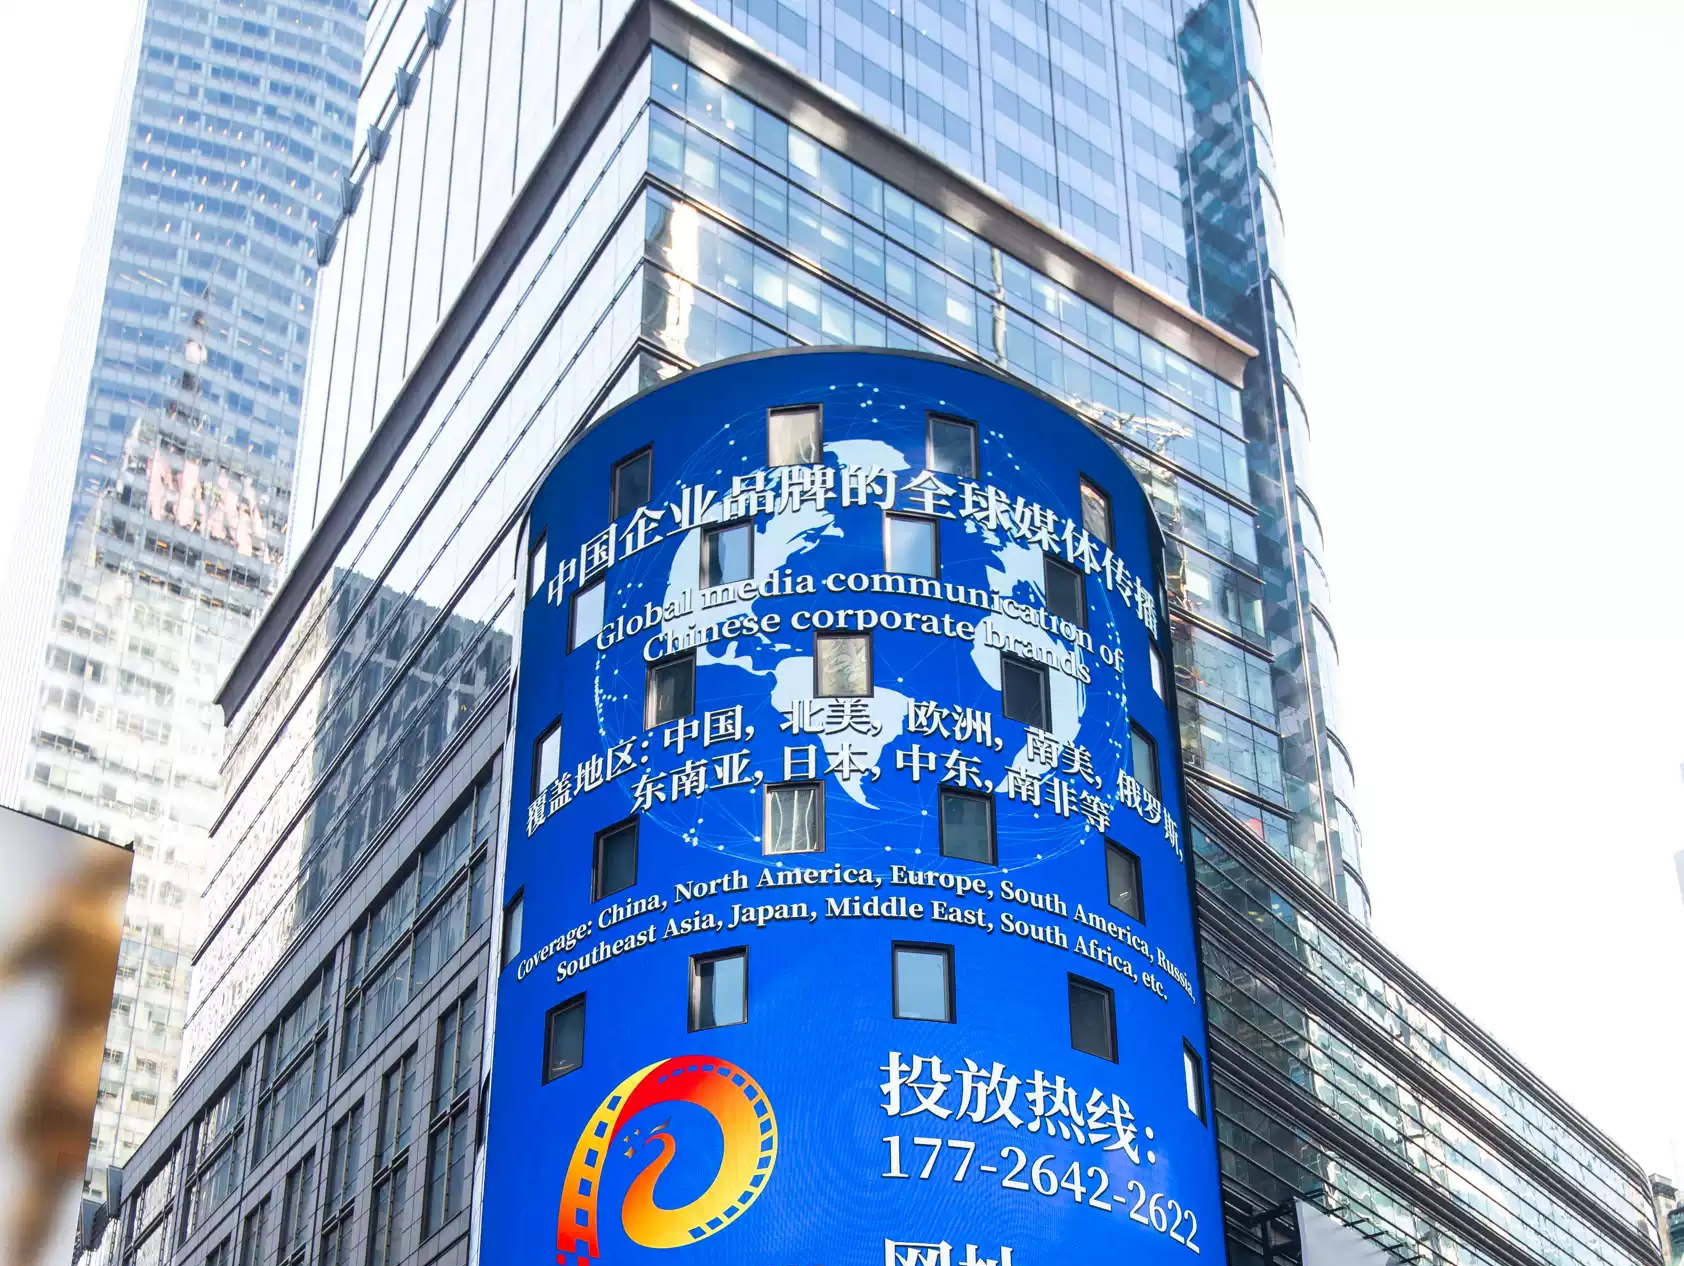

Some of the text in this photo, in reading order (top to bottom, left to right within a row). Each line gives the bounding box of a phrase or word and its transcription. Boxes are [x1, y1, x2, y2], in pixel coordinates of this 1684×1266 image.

[547, 463, 1159, 641] 中国企业品牌的全球媒体传播
[596, 568, 1126, 673] Global media communication of
[643, 608, 1092, 684] Chinese corporate brands
[516, 862, 1196, 1005] Coverage: China, North America, Europe, South America, Russia,
[556, 895, 1169, 1001] Southeast Asia, Japan, Middle East, South Africa, etc.
[881, 1135, 1201, 1255] 177-2642-2622
